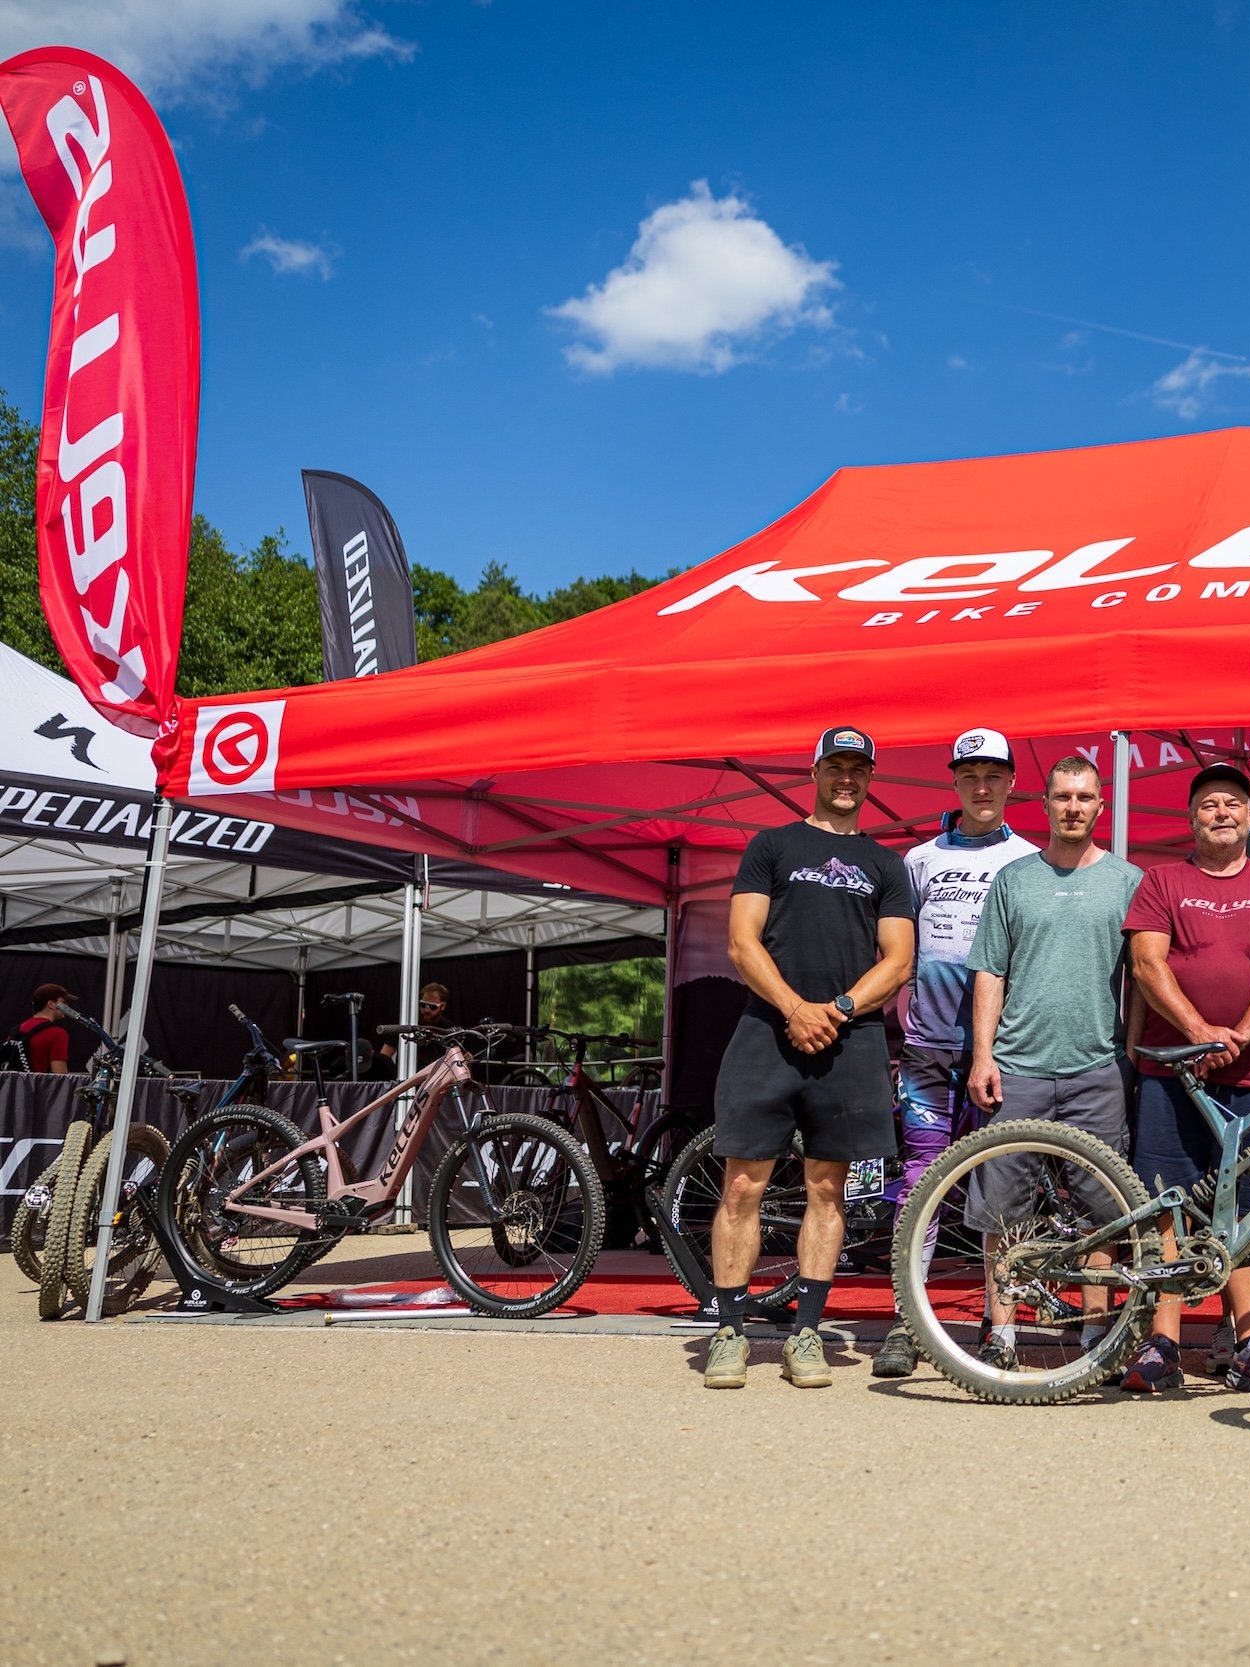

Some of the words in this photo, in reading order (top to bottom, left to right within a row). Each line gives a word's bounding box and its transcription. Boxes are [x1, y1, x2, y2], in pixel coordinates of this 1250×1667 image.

[862, 601, 1044, 627] BIKE
[789, 871, 874, 894] KELLYS
[380, 1088, 429, 1187] KELLYS
